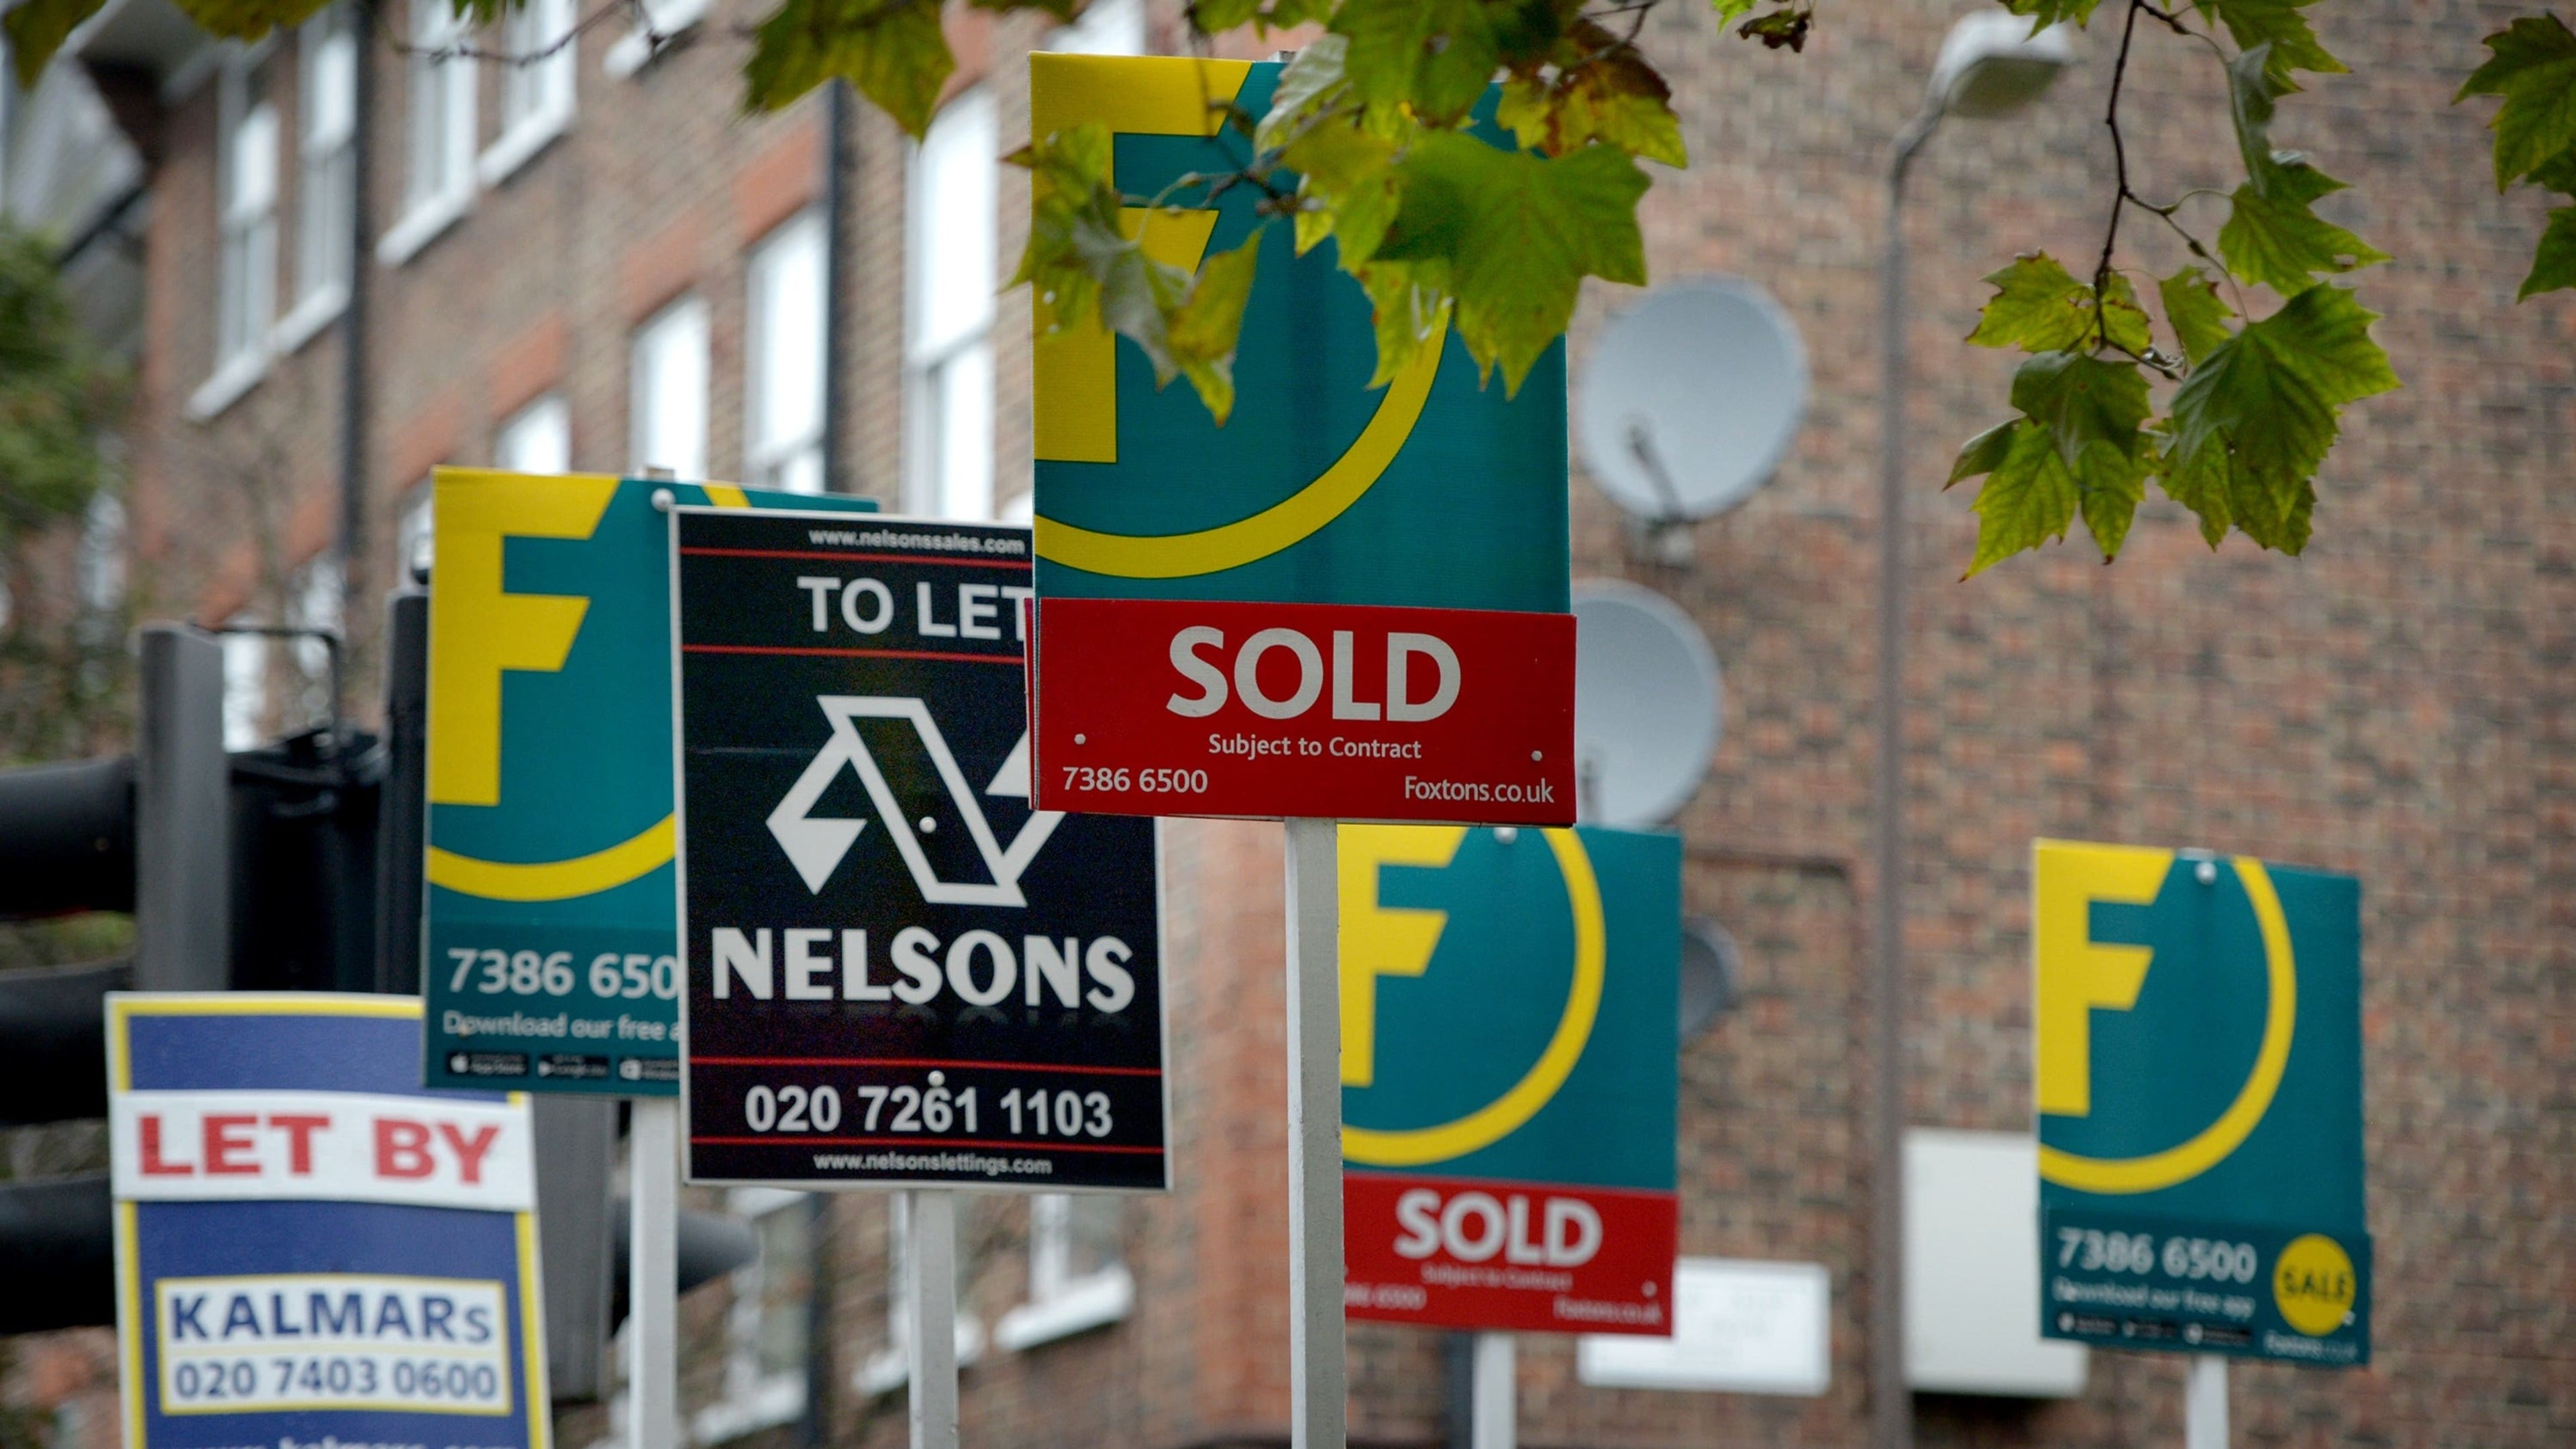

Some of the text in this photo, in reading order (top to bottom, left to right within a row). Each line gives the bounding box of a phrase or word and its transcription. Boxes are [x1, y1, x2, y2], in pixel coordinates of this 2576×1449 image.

[808, 529, 1026, 554] www.nelsonssales.com
[796, 576, 1032, 642] TO LET
[1166, 625, 1461, 722] SOLD
[1208, 733, 1422, 761] Subject to Contract
[1062, 765, 1208, 794] 7386 6500
[1403, 775, 1555, 804] Foxtons.co.uk
[447, 947, 576, 996] 7386
[712, 926, 1136, 1014] NELSONS
[443, 1010, 568, 1038] Download
[571, 1020, 613, 1039] our
[617, 1014, 667, 1041] free
[745, 1083, 1114, 1138] 020 7261 1103
[138, 1114, 502, 1187] LET BY
[813, 1151, 1053, 1177] www.nelsonslettings.com
[1393, 1187, 1603, 1268] SOLD
[2056, 1226, 2258, 1284] 7386 6500
[2282, 1267, 2349, 1303] SALE
[174, 1359, 498, 1399] 020 7403 0600
